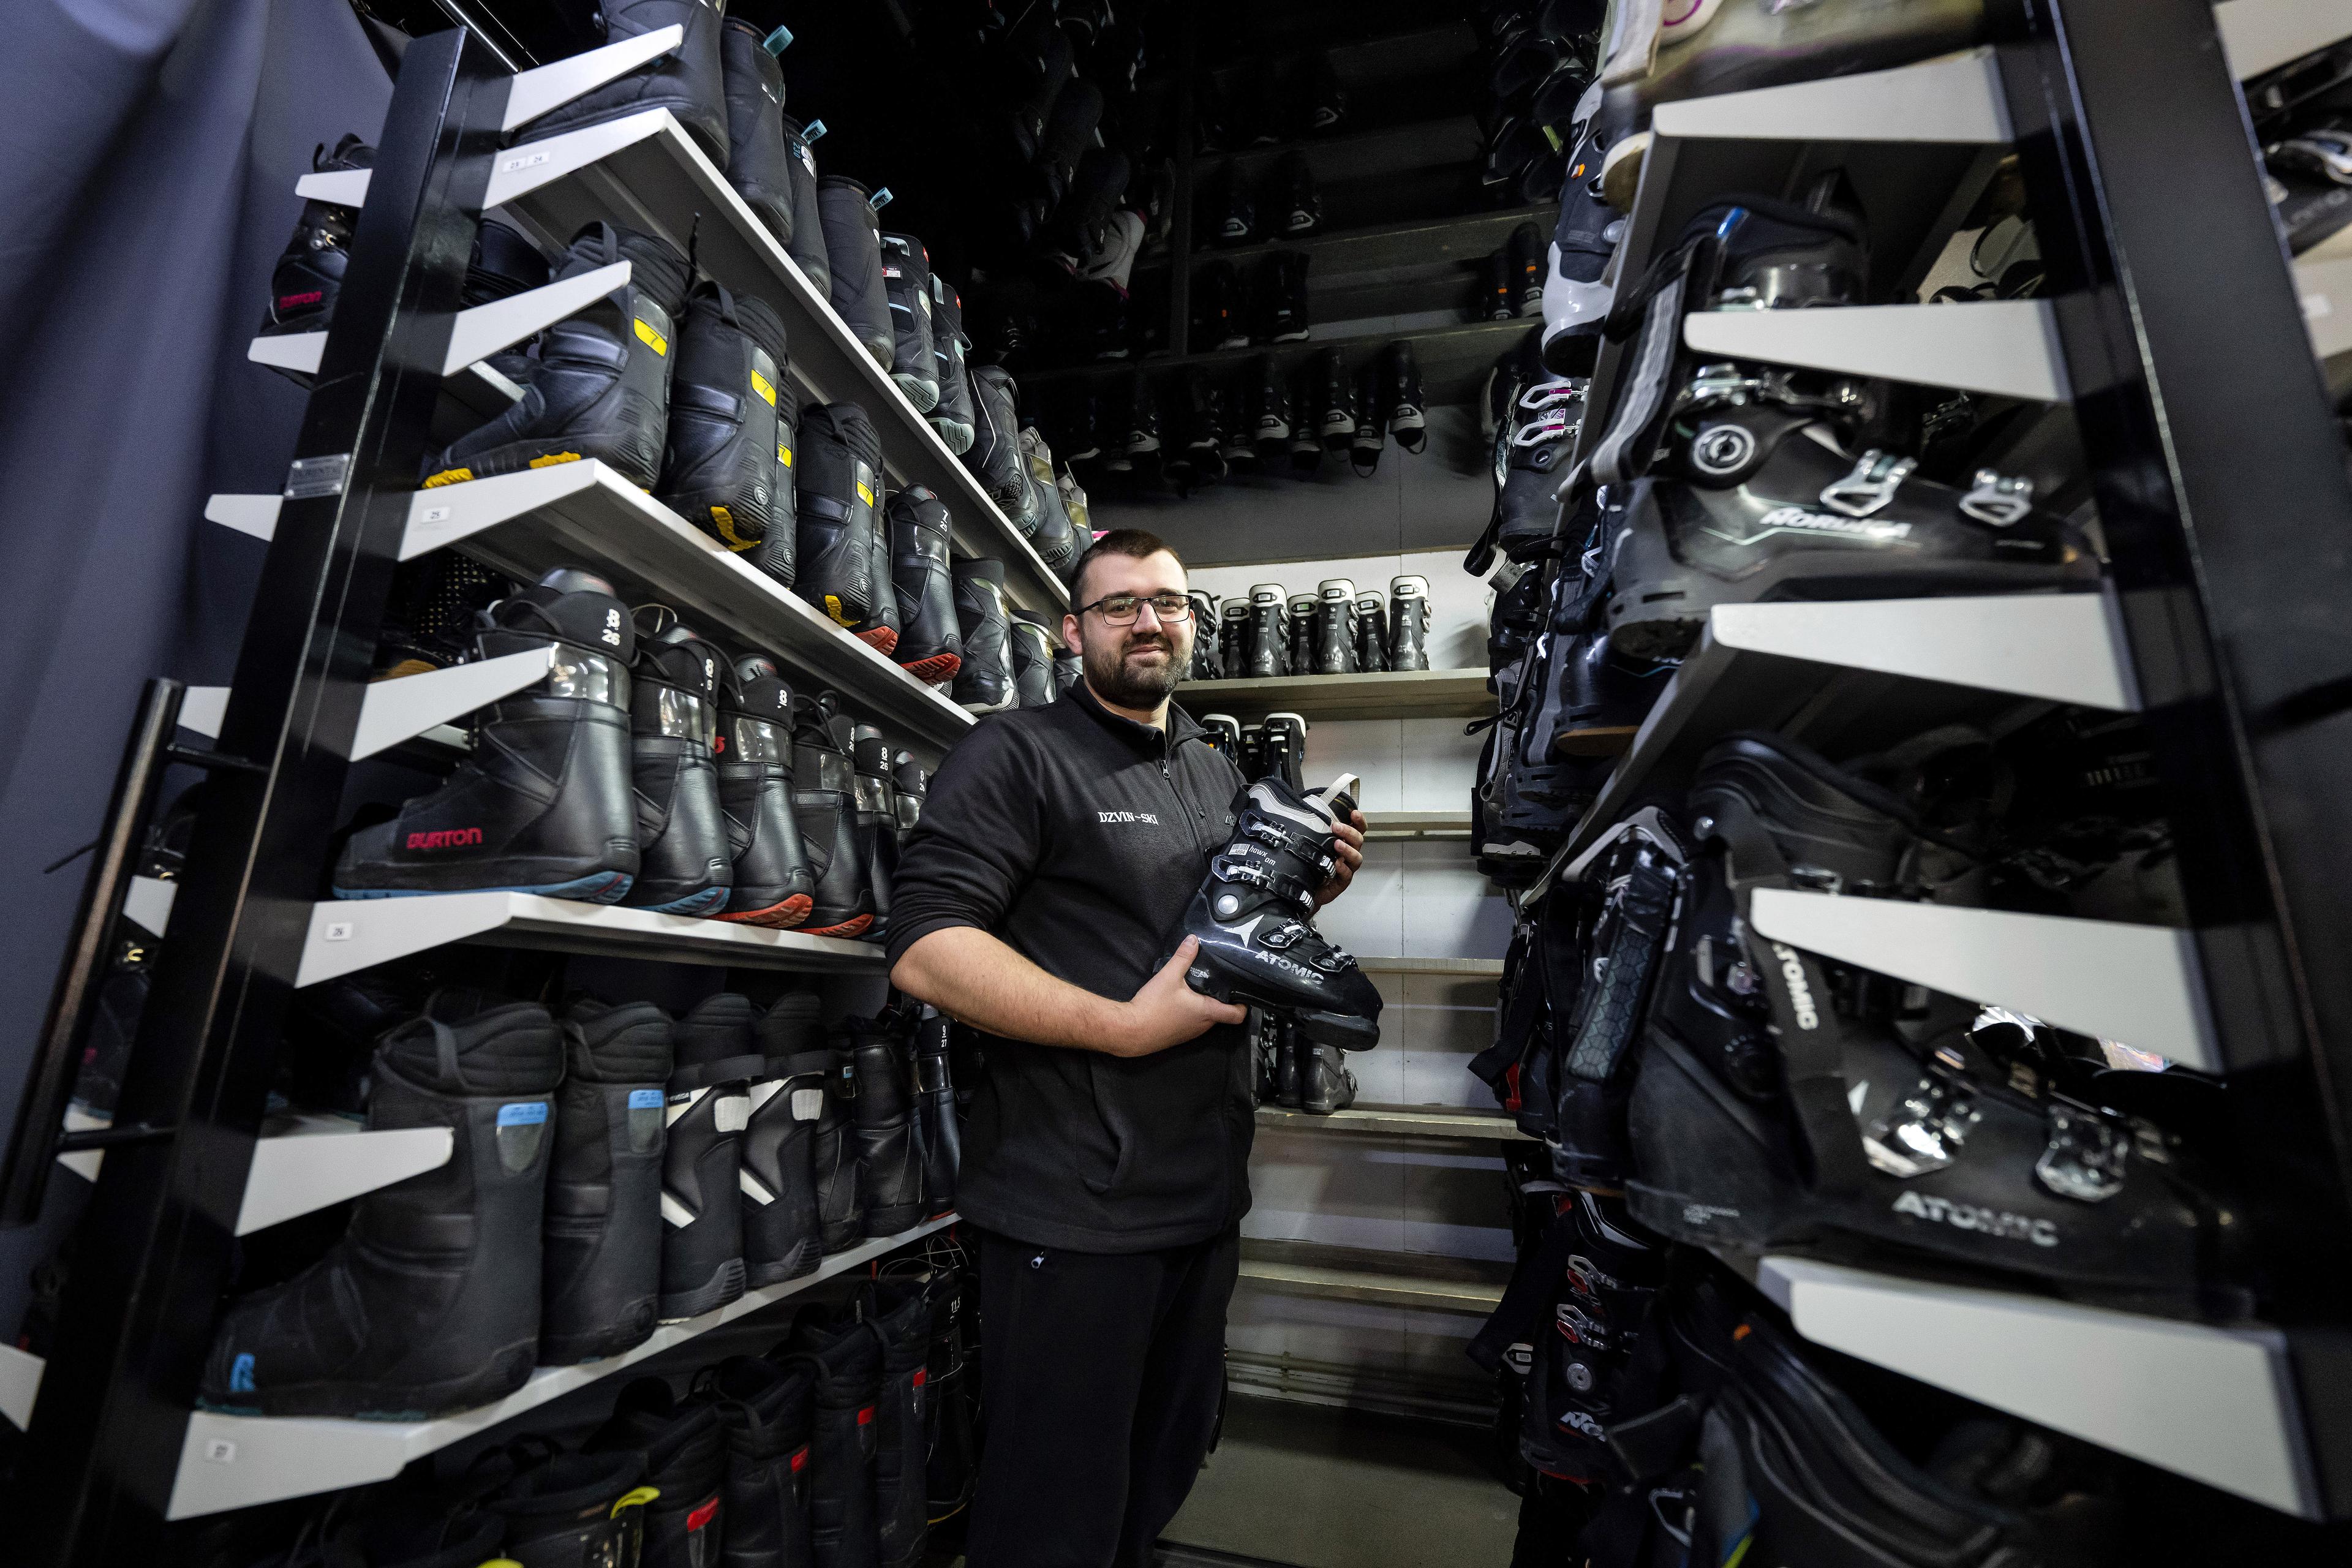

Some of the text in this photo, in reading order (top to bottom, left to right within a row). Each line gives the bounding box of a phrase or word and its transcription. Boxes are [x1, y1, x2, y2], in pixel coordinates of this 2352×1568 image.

[762, 380, 769, 394] 7
[606, 609, 620, 628] 8
[601, 628, 620, 646] 26
[881, 747, 888, 759] 8
[880, 761, 889, 771] 26
[406, 827, 483, 850] BURTON
[1248, 845, 1268, 858] hawx
[1264, 857, 1276, 866] am
[1255, 950, 1325, 985] ATOMIC
[942, 1025, 947, 1036] 9
[941, 1039, 948, 1048] 27
[1891, 1190, 2061, 1248] ATOMIC
